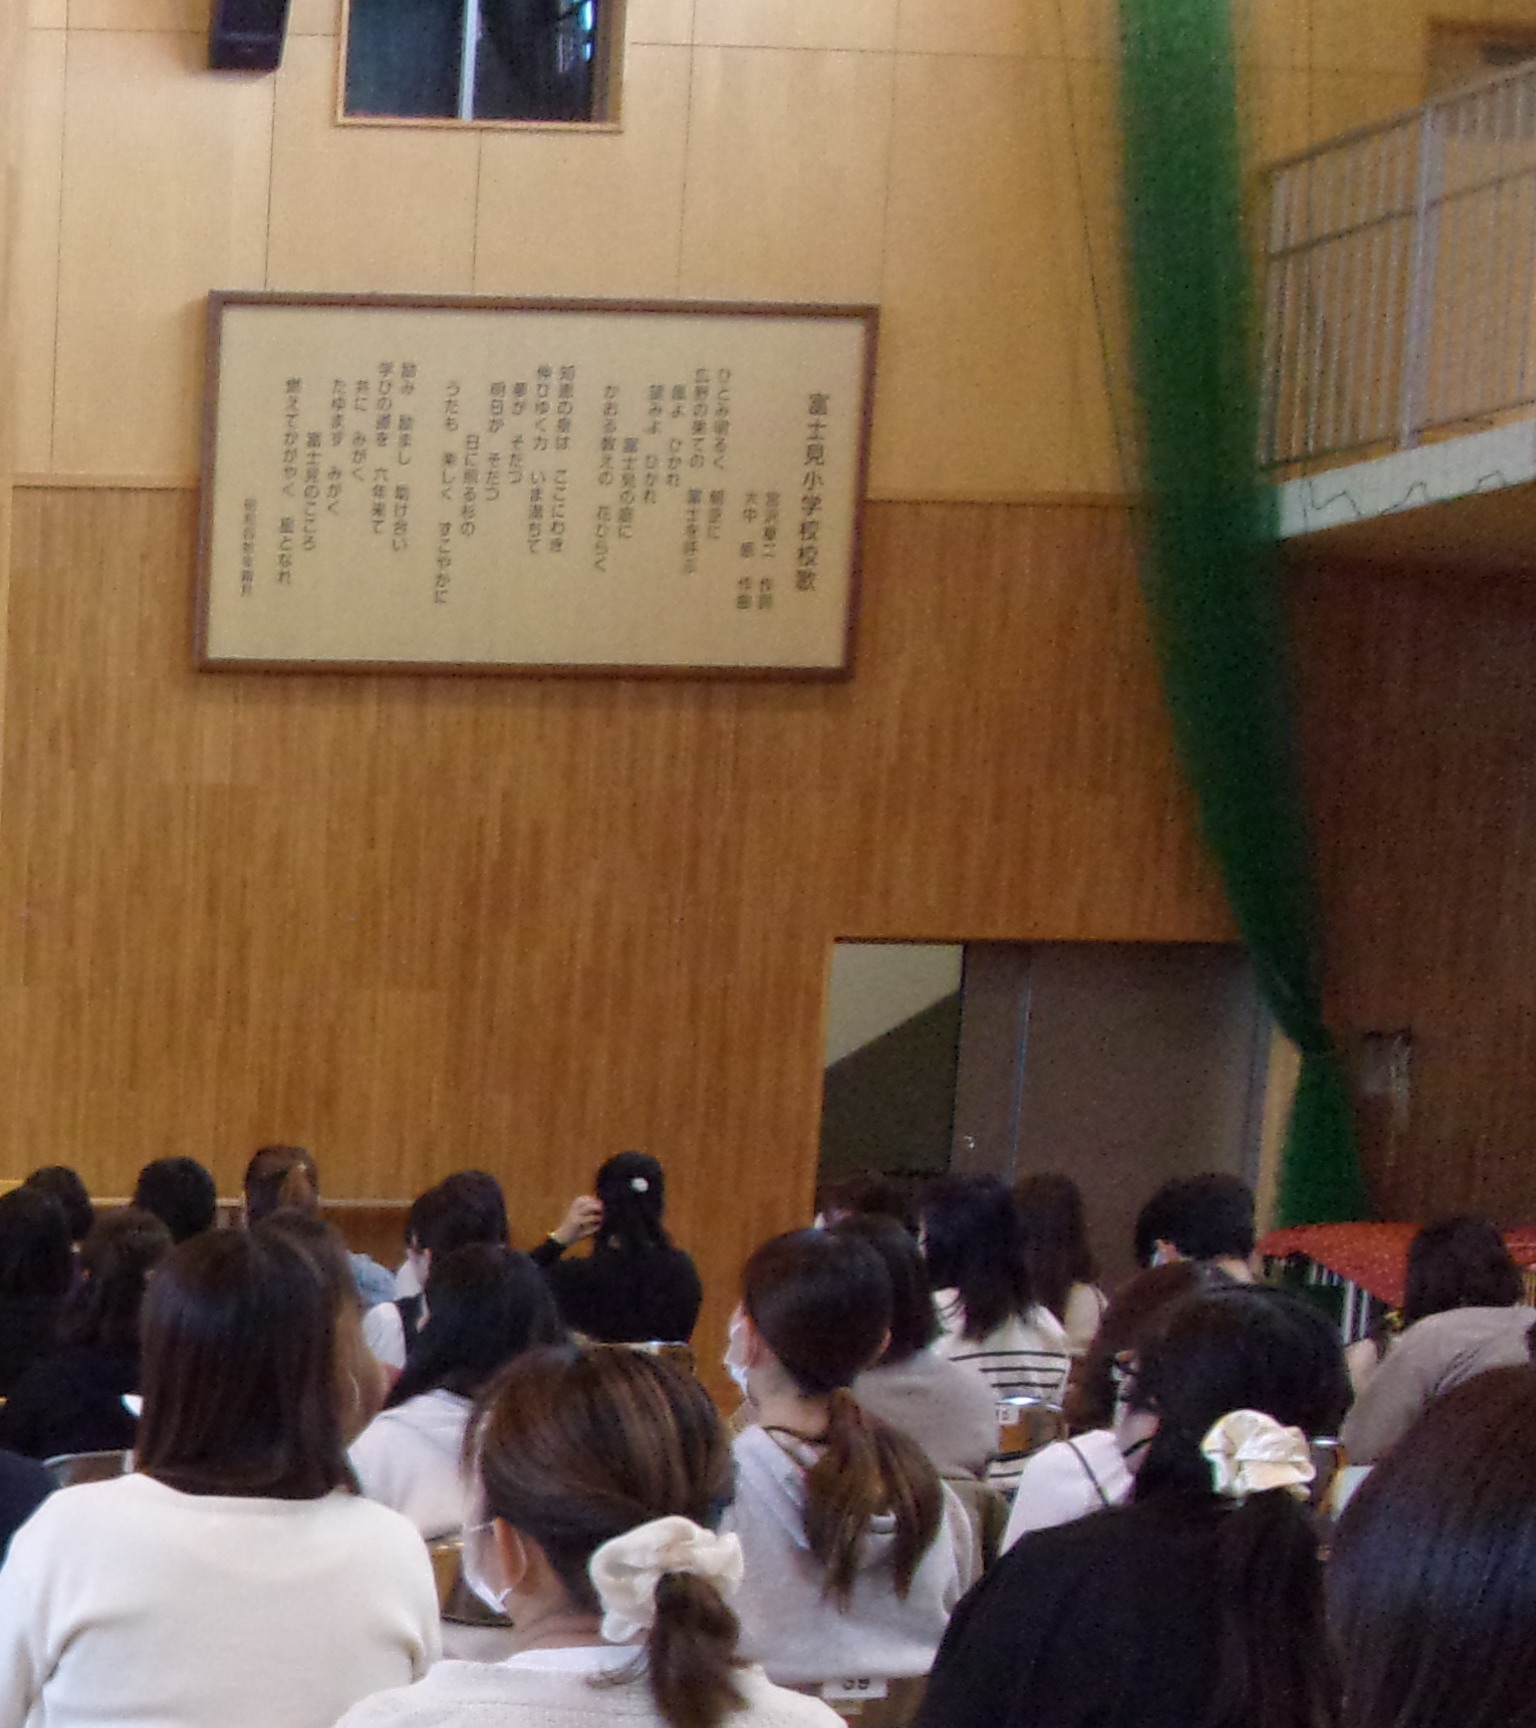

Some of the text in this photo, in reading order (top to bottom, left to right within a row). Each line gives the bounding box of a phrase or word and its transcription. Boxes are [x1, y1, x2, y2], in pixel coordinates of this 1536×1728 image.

[794, 392, 830, 592] 富士見小学校校歌
